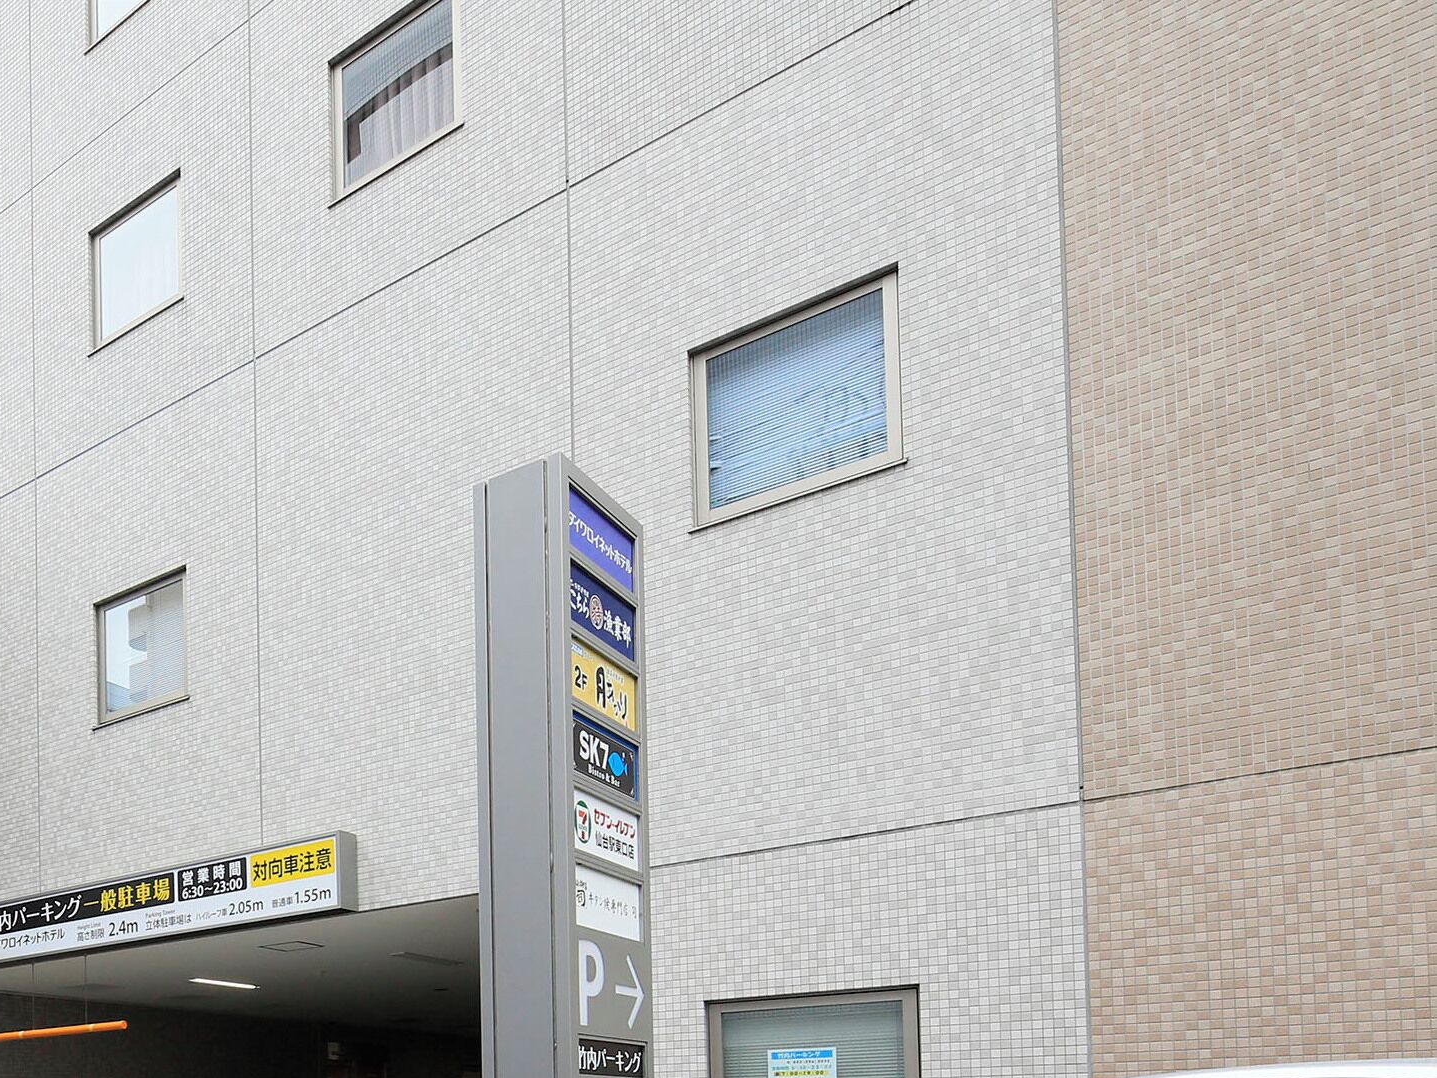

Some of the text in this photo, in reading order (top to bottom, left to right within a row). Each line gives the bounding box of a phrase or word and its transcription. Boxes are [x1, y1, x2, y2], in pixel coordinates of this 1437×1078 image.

[575, 665, 587, 690] 2F
[579, 730, 609, 770] SK7
[595, 831, 634, 860] 仙台駅東口店
[182, 861, 242, 886] 営業時間
[253, 848, 332, 882] 対向車注意
[109, 920, 139, 937] 2.4m
[229, 900, 263, 916] 2.05m
[294, 888, 332, 905] 1.55m
[579, 940, 604, 1026] P
